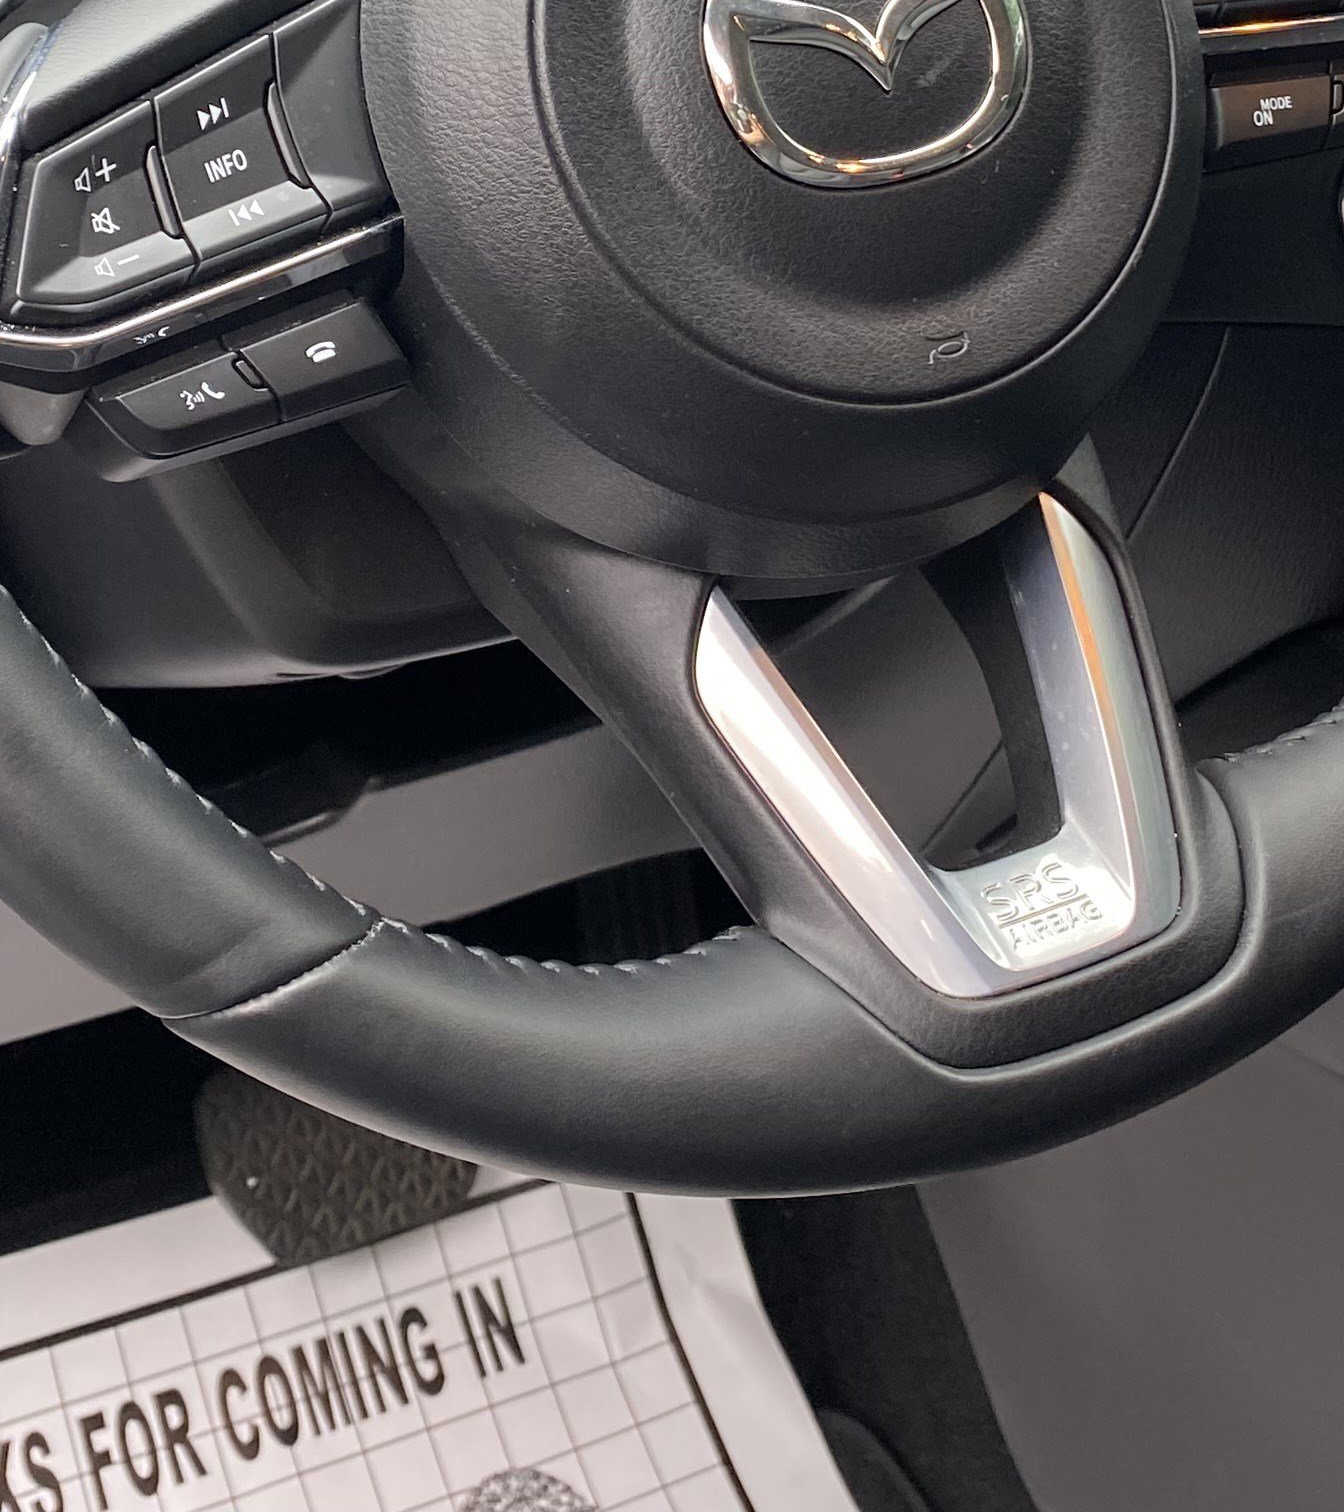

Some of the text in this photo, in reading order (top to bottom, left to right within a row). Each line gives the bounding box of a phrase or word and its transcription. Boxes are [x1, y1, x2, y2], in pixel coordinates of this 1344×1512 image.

[1253, 109, 1274, 127] ON
[1260, 94, 1292, 111] MODE
[204, 149, 248, 183] INFO
[980, 861, 1079, 920] SRS
[1010, 900, 1103, 950] AIRBAG
[79, 1386, 209, 1510] FOR
[215, 1304, 447, 1462] COMING
[452, 1277, 528, 1378] IN
